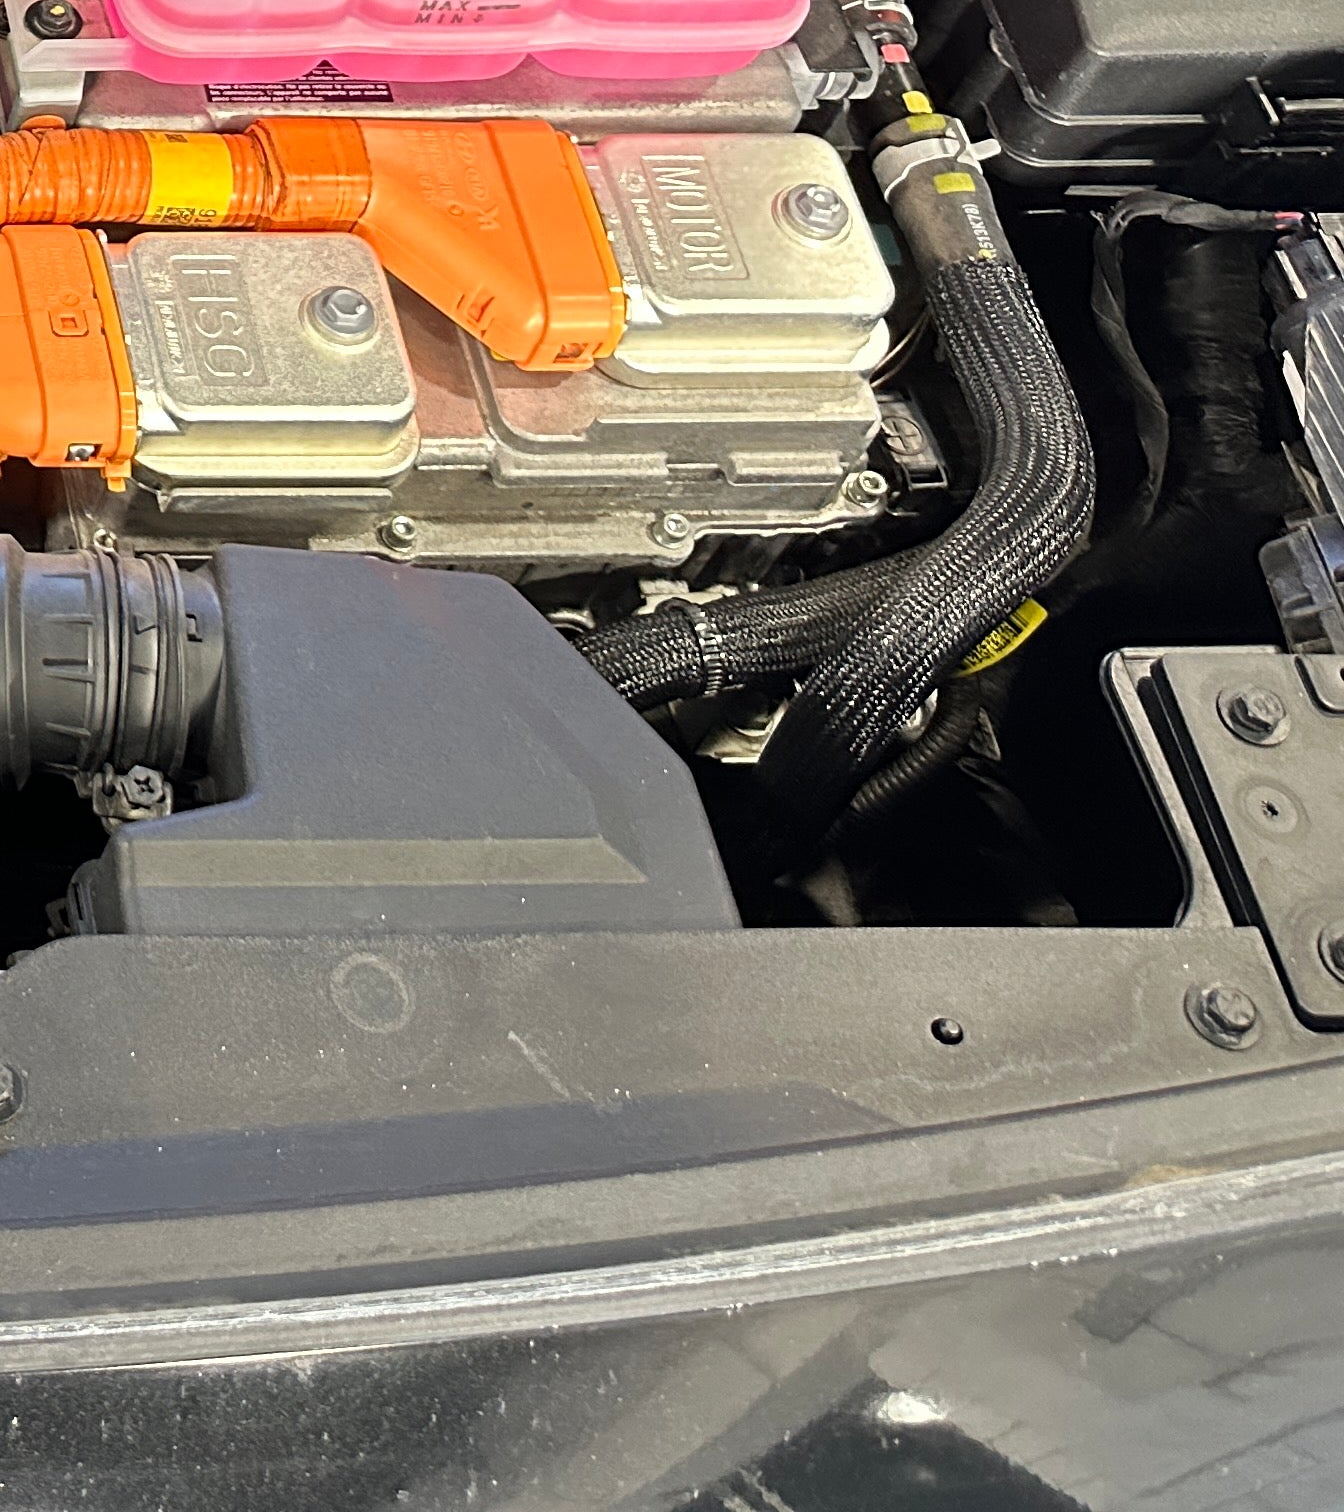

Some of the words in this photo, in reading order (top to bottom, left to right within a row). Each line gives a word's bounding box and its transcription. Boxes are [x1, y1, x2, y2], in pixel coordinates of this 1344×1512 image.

[414, 13, 464, 24] MIN
[419, 0, 471, 11] MAX
[655, 167, 734, 273] MOTOR
[181, 268, 255, 377] HSG
